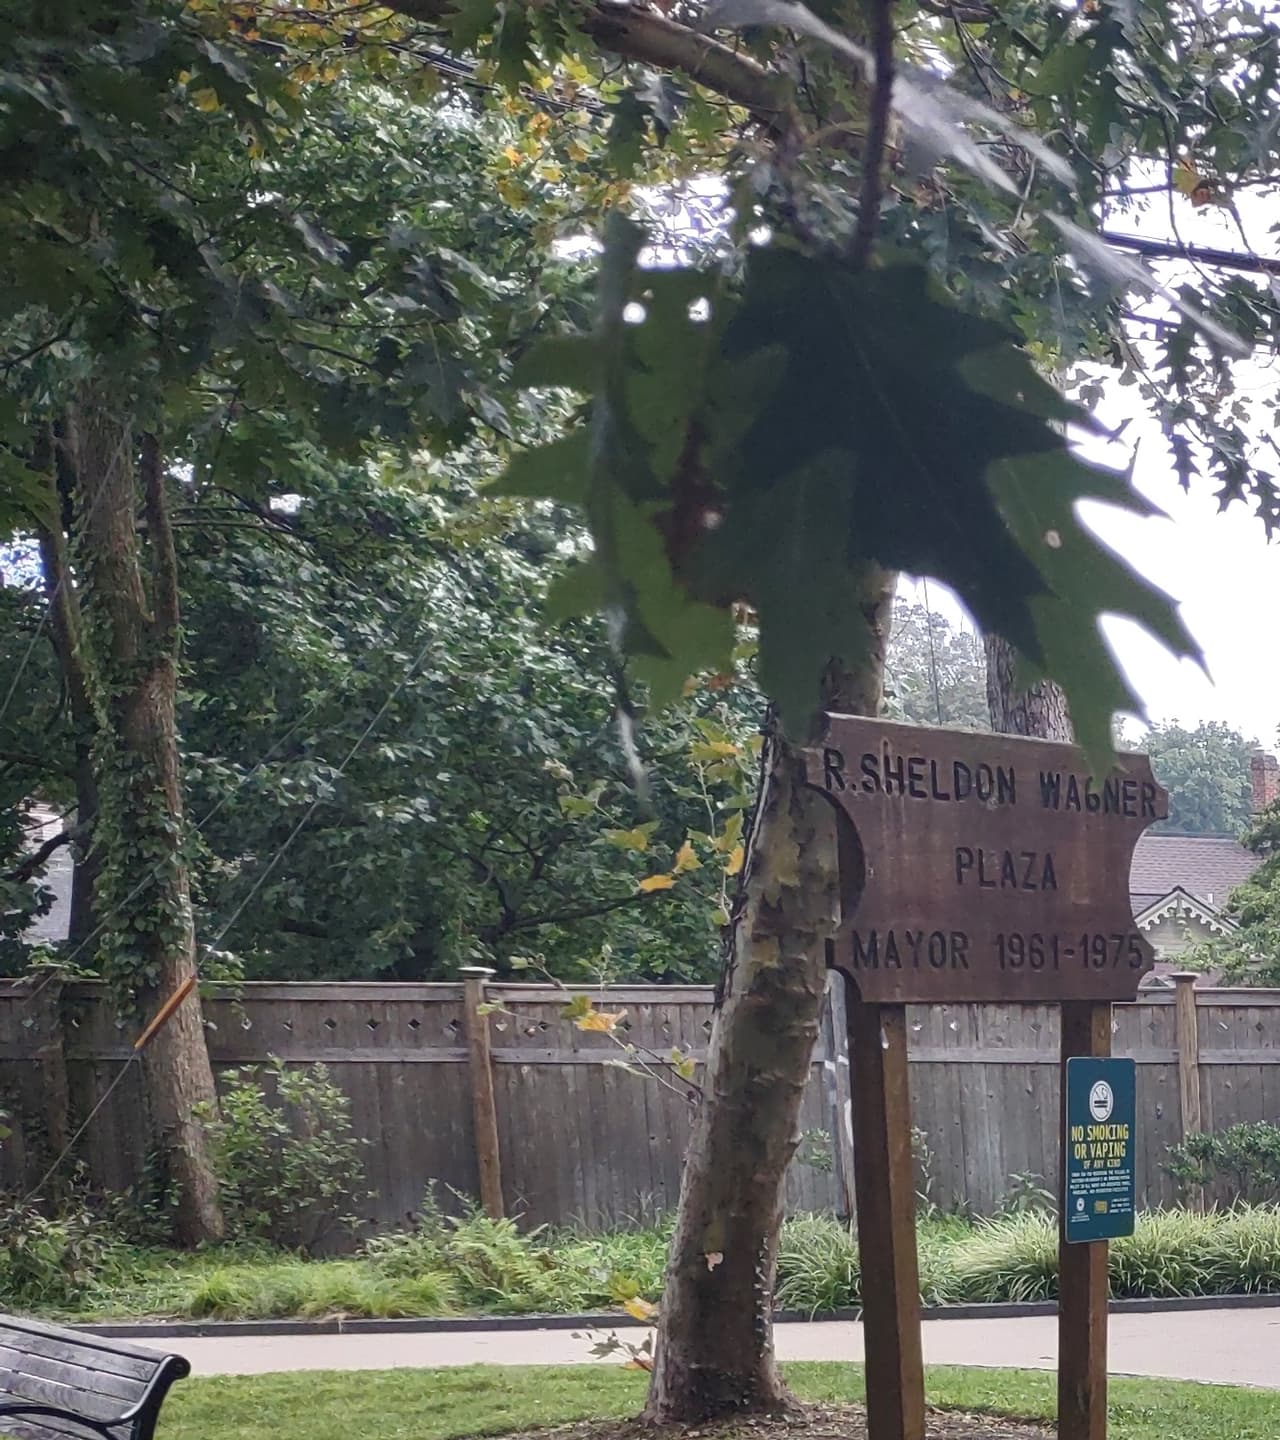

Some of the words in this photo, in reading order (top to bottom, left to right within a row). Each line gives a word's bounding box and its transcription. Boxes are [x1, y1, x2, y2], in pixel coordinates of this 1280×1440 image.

[1039, 771, 1156, 818] WAGNER
[955, 846, 1058, 890] PLAZA
[852, 930, 969, 970] MAYOR
[993, 933, 1143, 971] 1961-1975
[1071, 1125, 1084, 1142] NO
[1087, 1124, 1129, 1141] SMOKING
[1074, 1143, 1088, 1160] OR
[1090, 1141, 1126, 1158] VAPING
[1093, 1160, 1105, 1168] ANY
